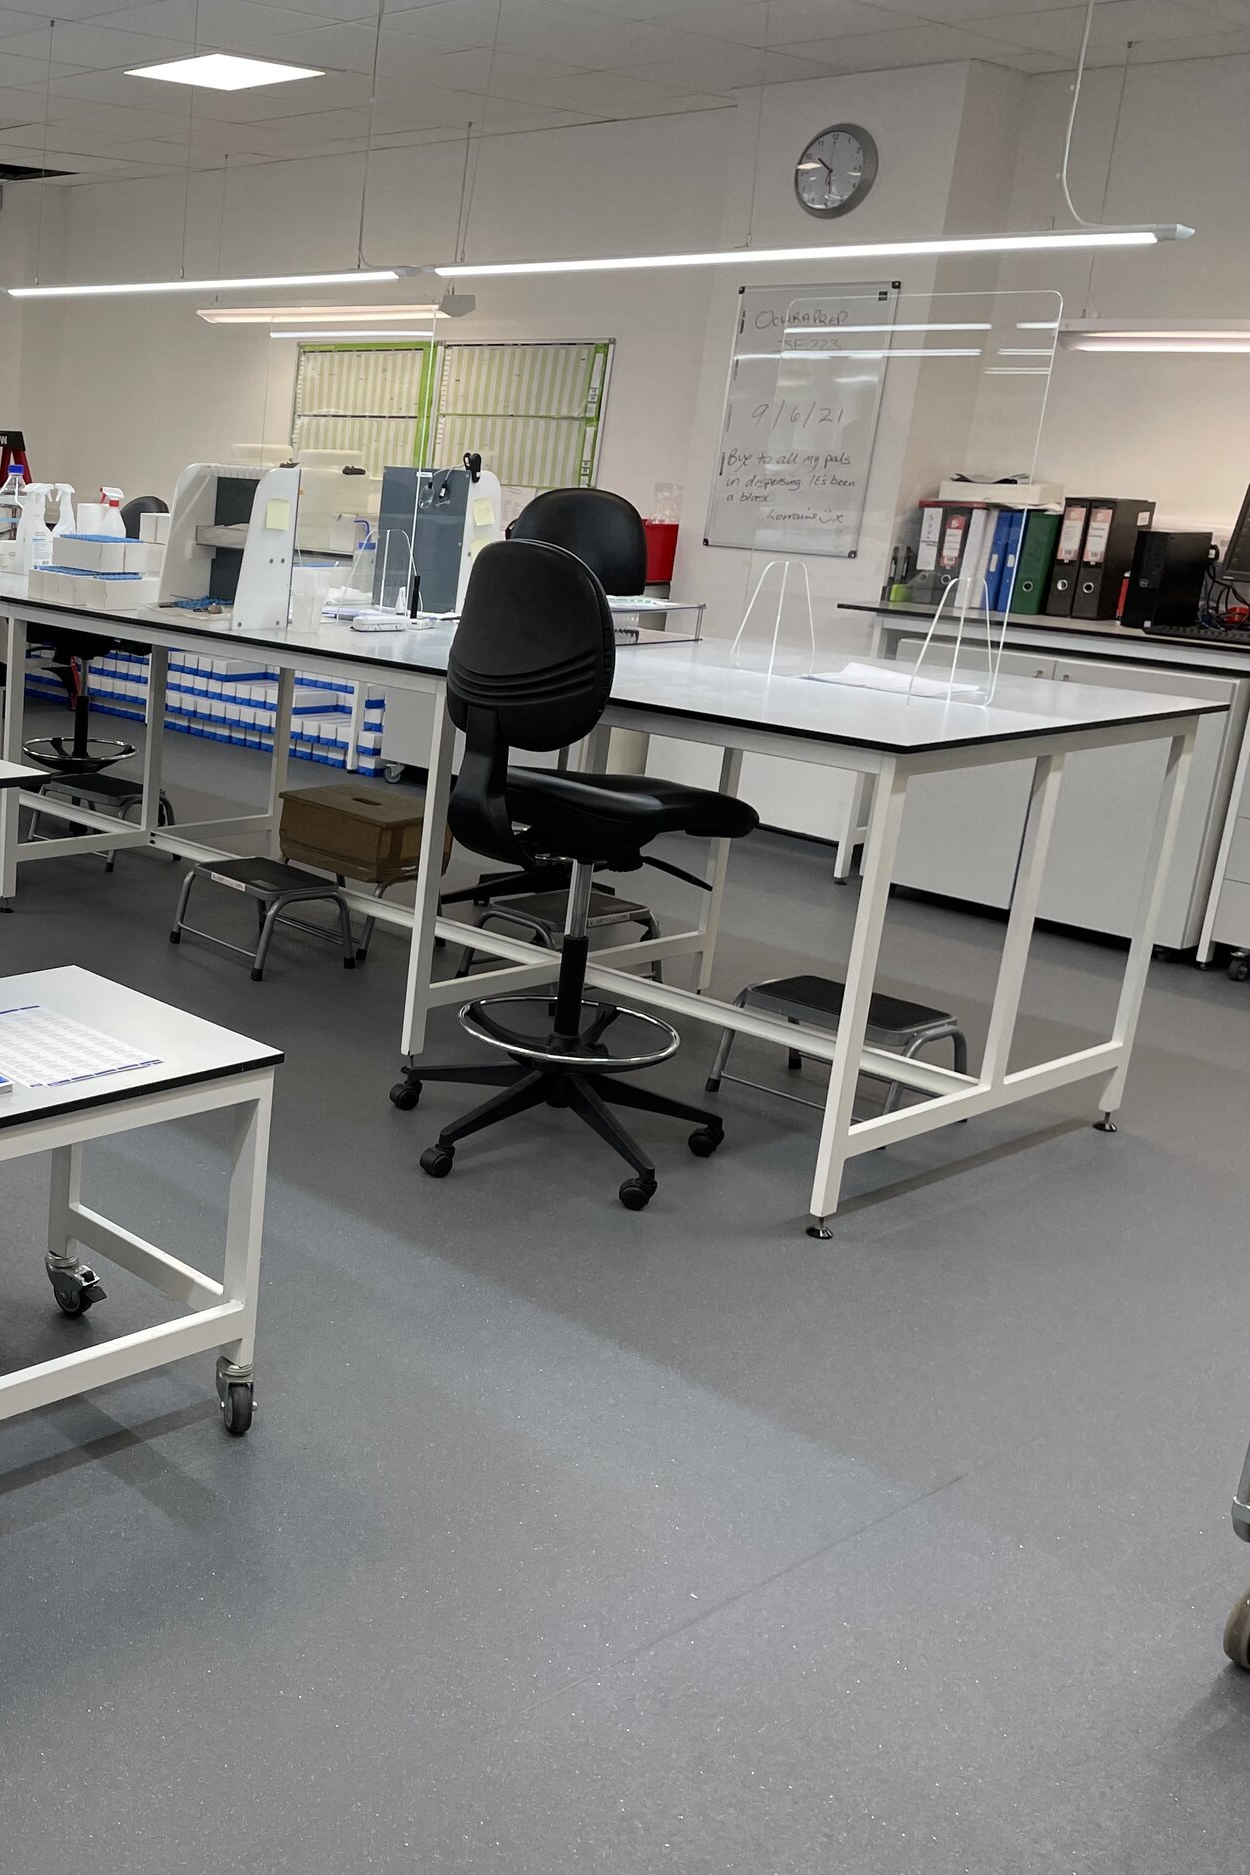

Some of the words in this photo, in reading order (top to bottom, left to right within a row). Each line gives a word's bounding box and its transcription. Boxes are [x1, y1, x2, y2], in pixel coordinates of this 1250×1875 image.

[727, 448, 752, 472] Bye
[756, 453, 772, 464] to
[776, 452, 798, 464] all
[803, 456, 819, 473] my
[824, 452, 851, 469] pals
[726, 477, 740, 487] in
[830, 475, 855, 487] been
